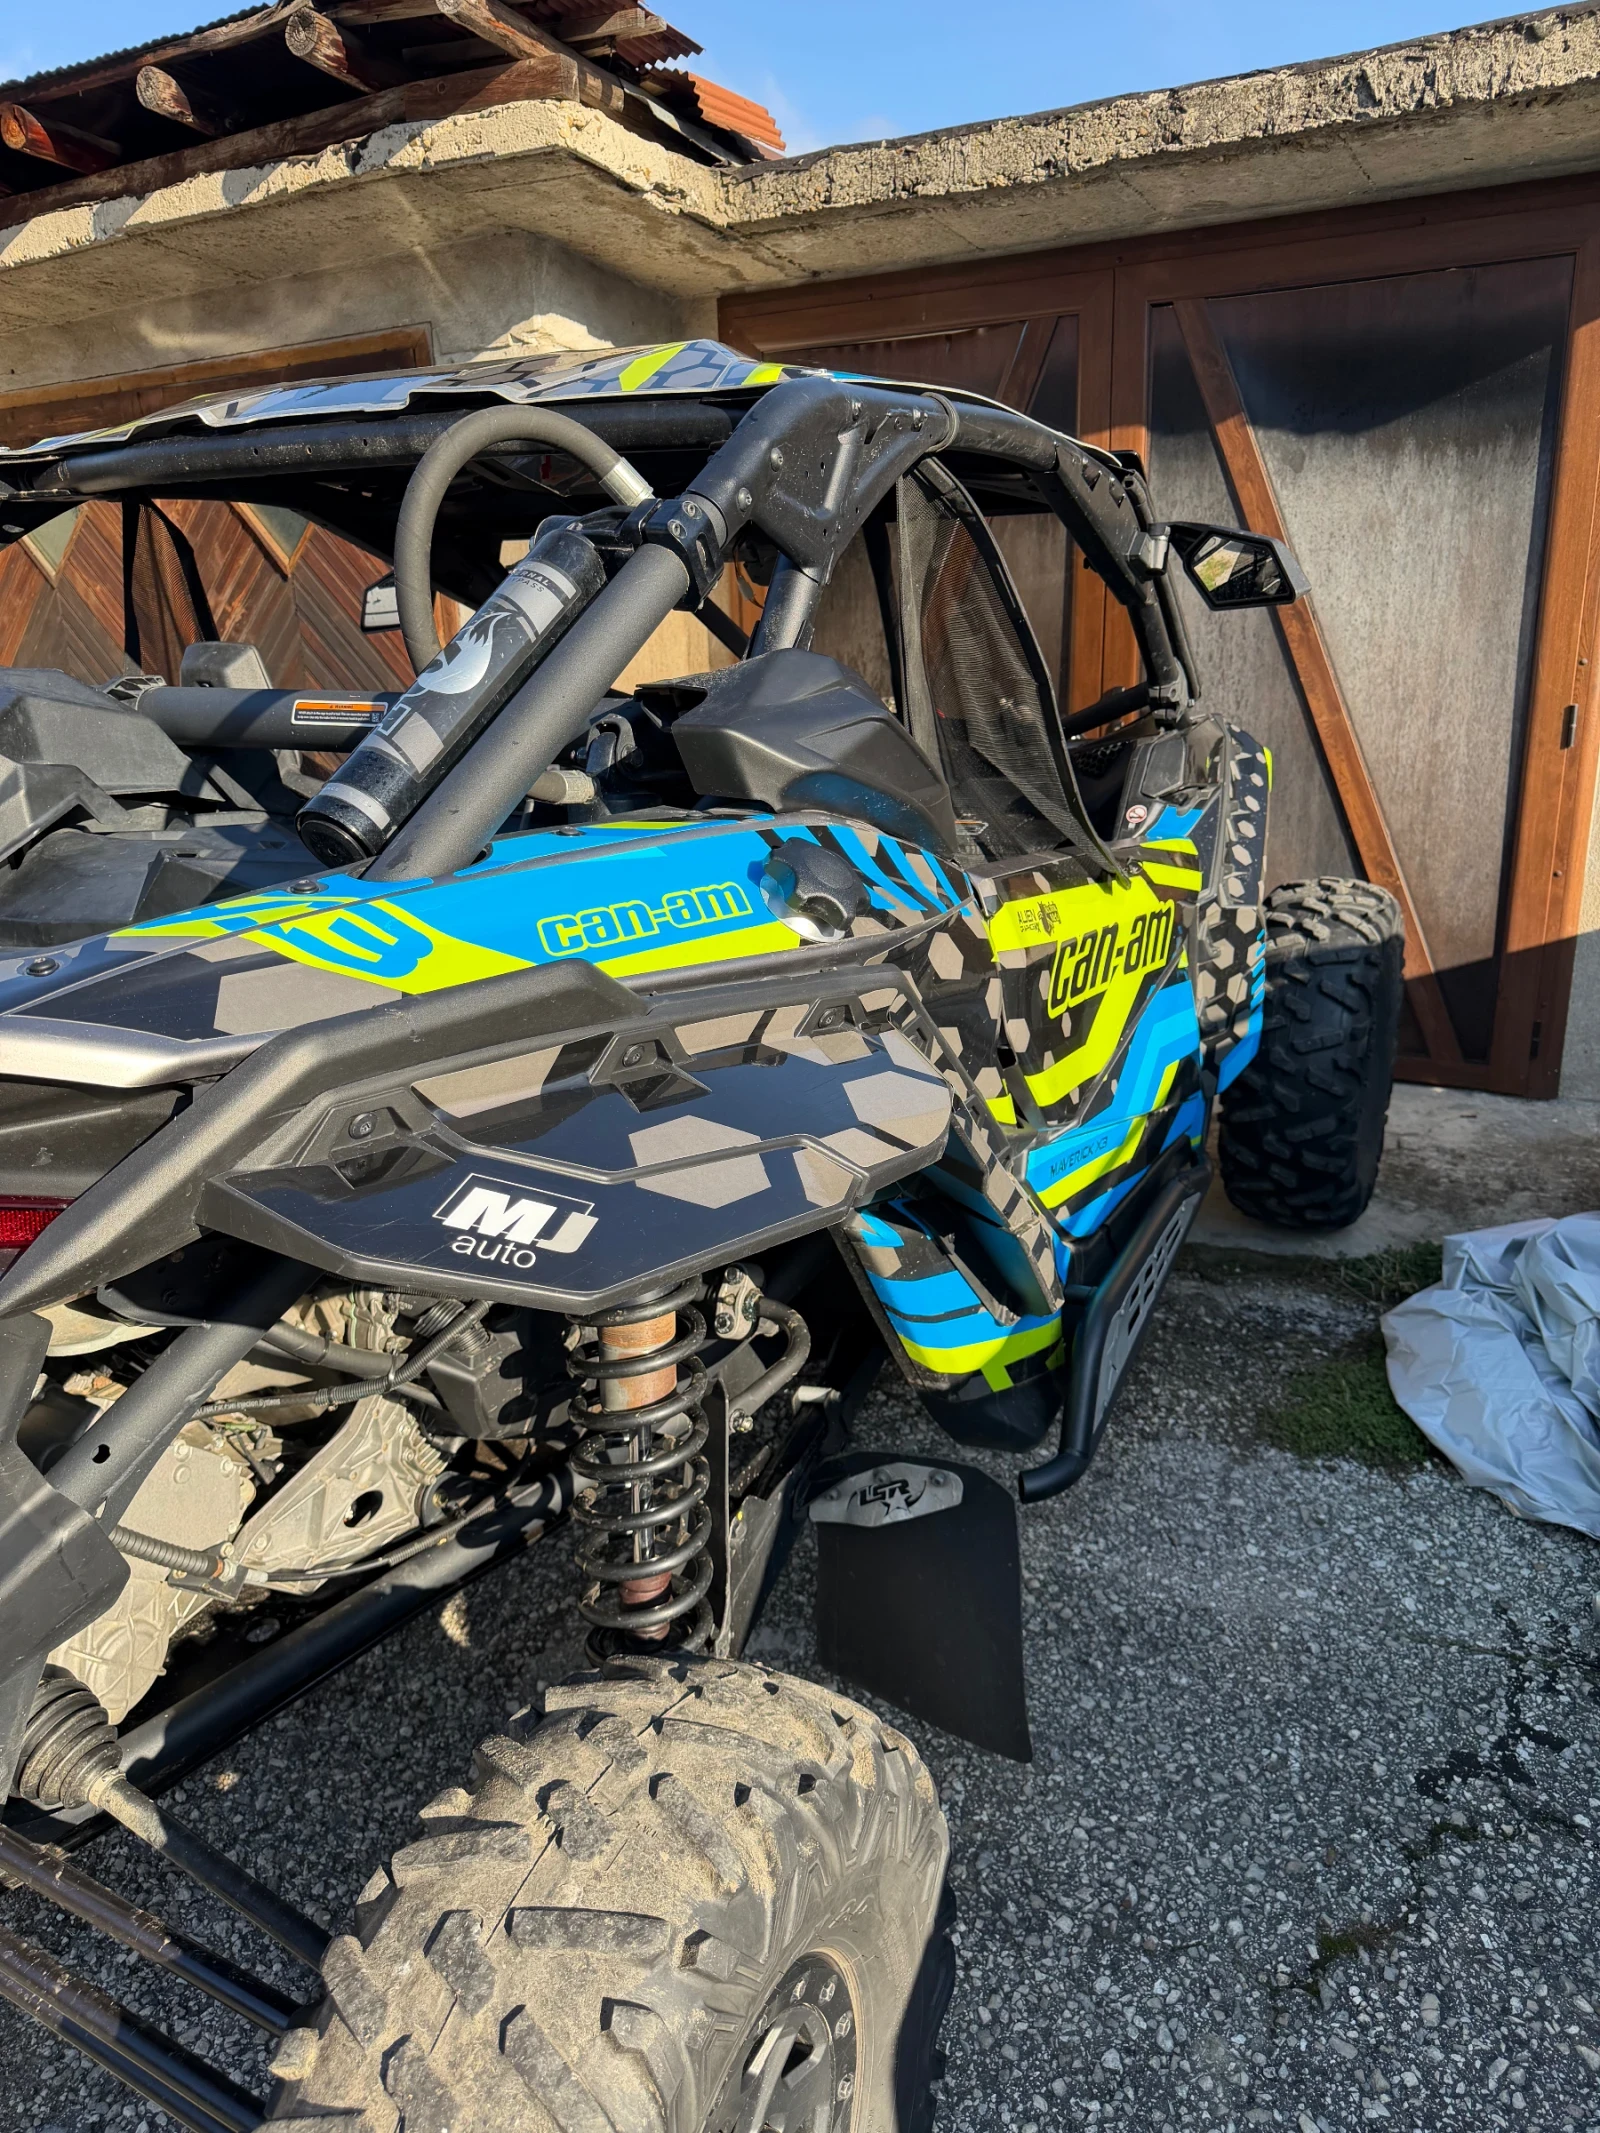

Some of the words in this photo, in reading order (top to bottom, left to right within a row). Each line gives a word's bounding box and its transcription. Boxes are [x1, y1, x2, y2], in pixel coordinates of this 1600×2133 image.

[536, 881, 753, 957] can-am
[1048, 900, 1175, 1017] can-am
[1050, 1142, 1095, 1178] MAVERICK
[442, 1187, 599, 1253] MJ
[451, 1235, 536, 1269] auto
